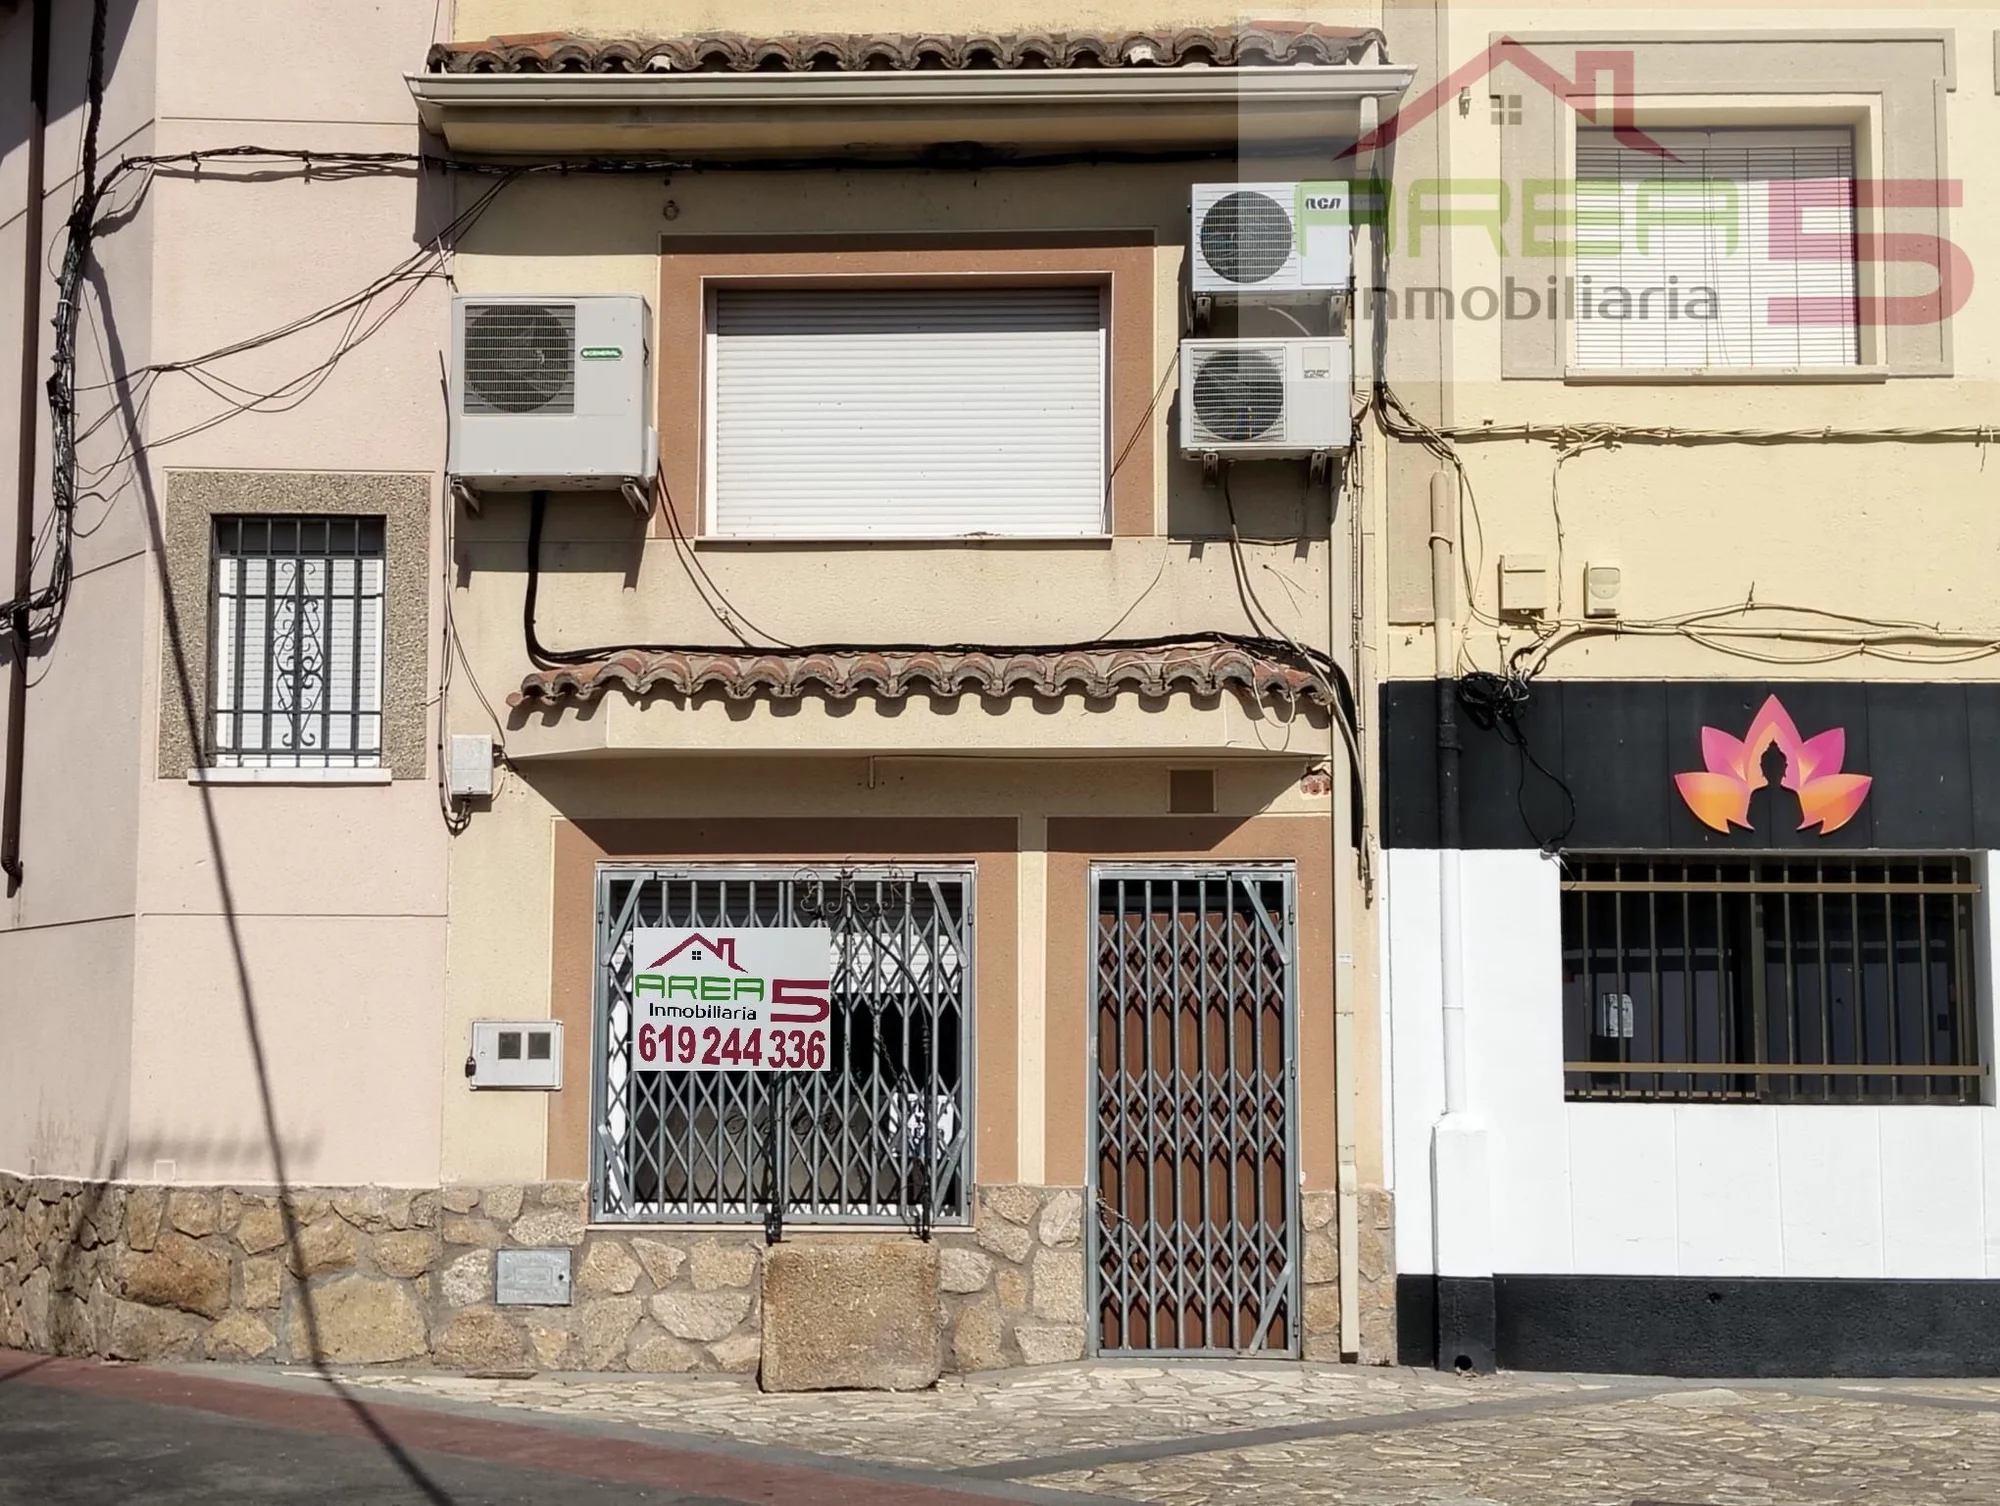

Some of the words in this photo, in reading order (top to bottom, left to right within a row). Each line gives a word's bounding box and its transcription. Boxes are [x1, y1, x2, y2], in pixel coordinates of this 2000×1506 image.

[1305, 197, 1342, 210] RCA
[635, 974, 765, 1002] AREA
[770, 979, 830, 1024] 5
[649, 1003, 757, 1021] Inmobiliaria
[638, 1023, 697, 1063] 619
[701, 1026, 763, 1067] 244
[767, 1029, 827, 1070] 336
